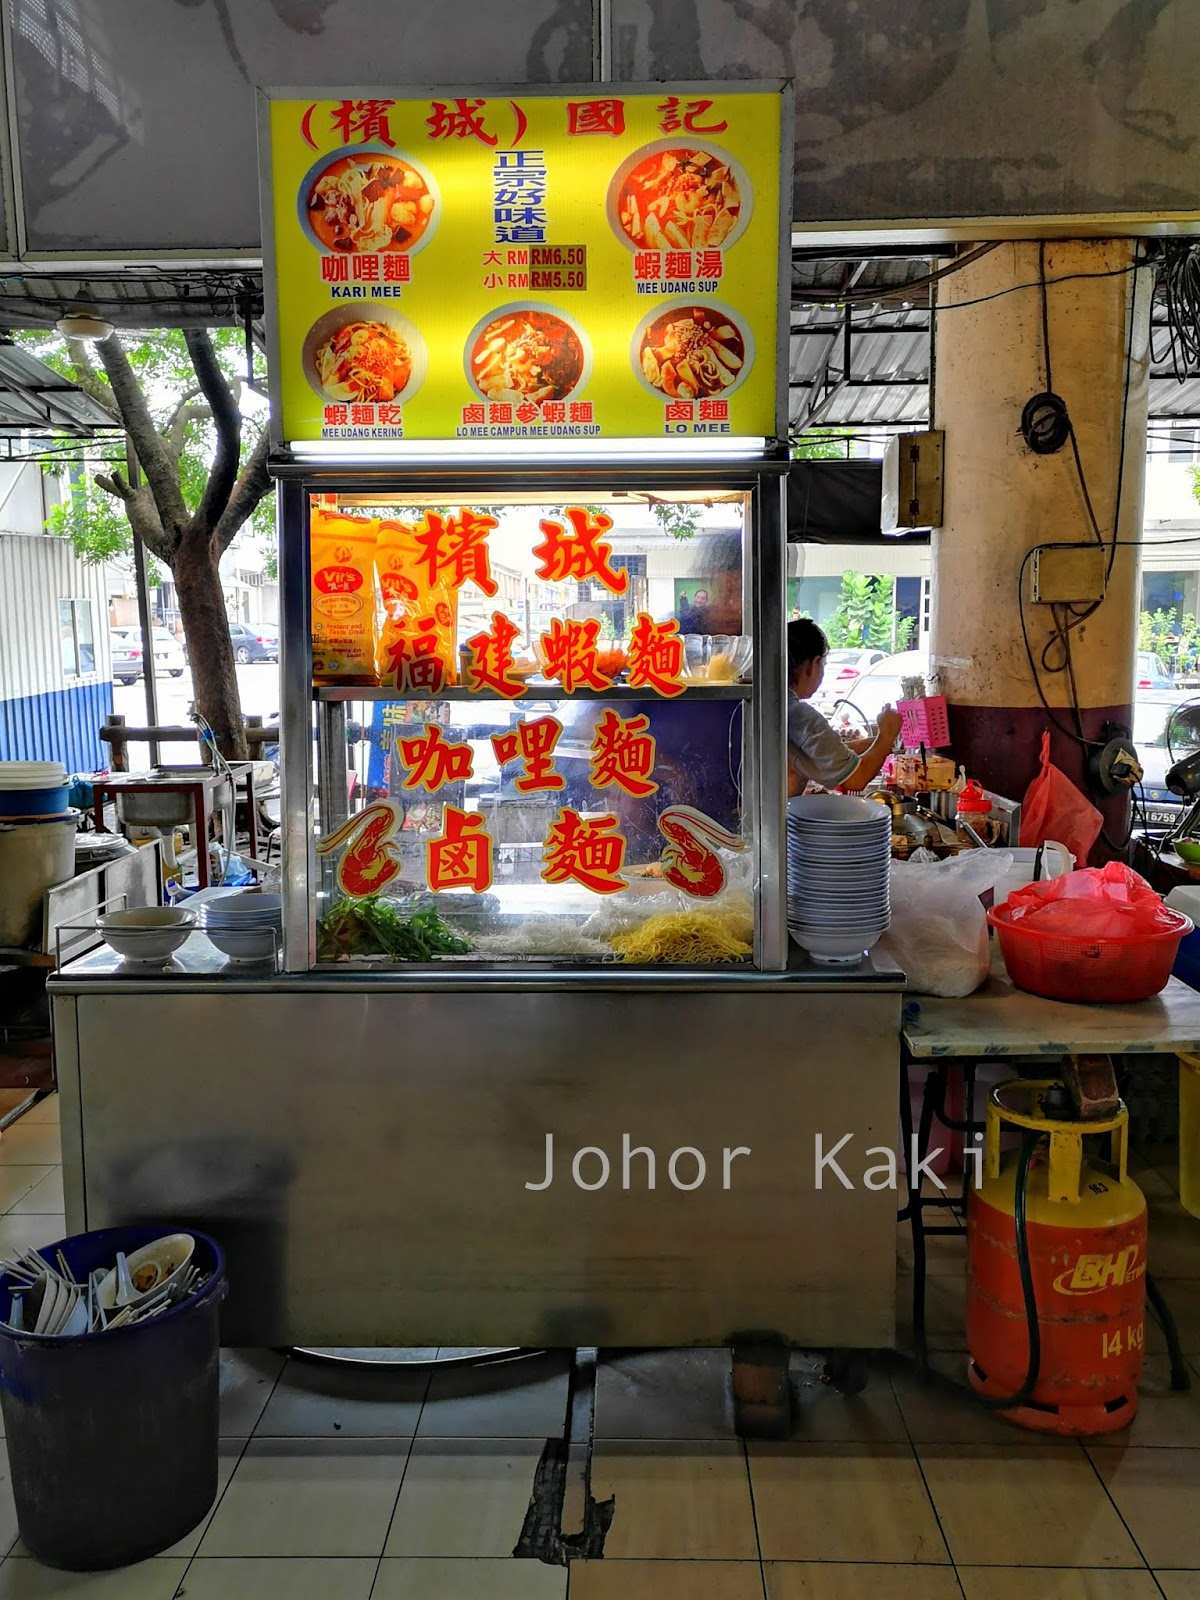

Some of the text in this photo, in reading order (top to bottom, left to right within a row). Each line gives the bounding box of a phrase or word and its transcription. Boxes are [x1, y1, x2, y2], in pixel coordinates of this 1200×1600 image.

[493, 150, 547, 244] 正宗好味道
[483, 248, 584, 267] 大 RM RM6.50
[634, 250, 723, 281] 蝦麵湯
[321, 254, 411, 282] 咖哩麵
[483, 271, 584, 289] 小 RM RM5.50
[637, 281, 718, 294] MEE UDANG SUP
[331, 286, 401, 298] KARI MEE
[324, 404, 402, 426] 蝦麵乾
[322, 427, 403, 438] MEE UDANG KERING
[456, 425, 600, 437] LO MEE CAMPUR MEE UDANG SUP
[665, 423, 730, 434] LO MEE
[386, 610, 688, 699] 福建蝦麵
[397, 707, 662, 798] 咖哩麵
[1151, 812, 1176, 823] 6759
[1102, 1330, 1124, 1359] 14
